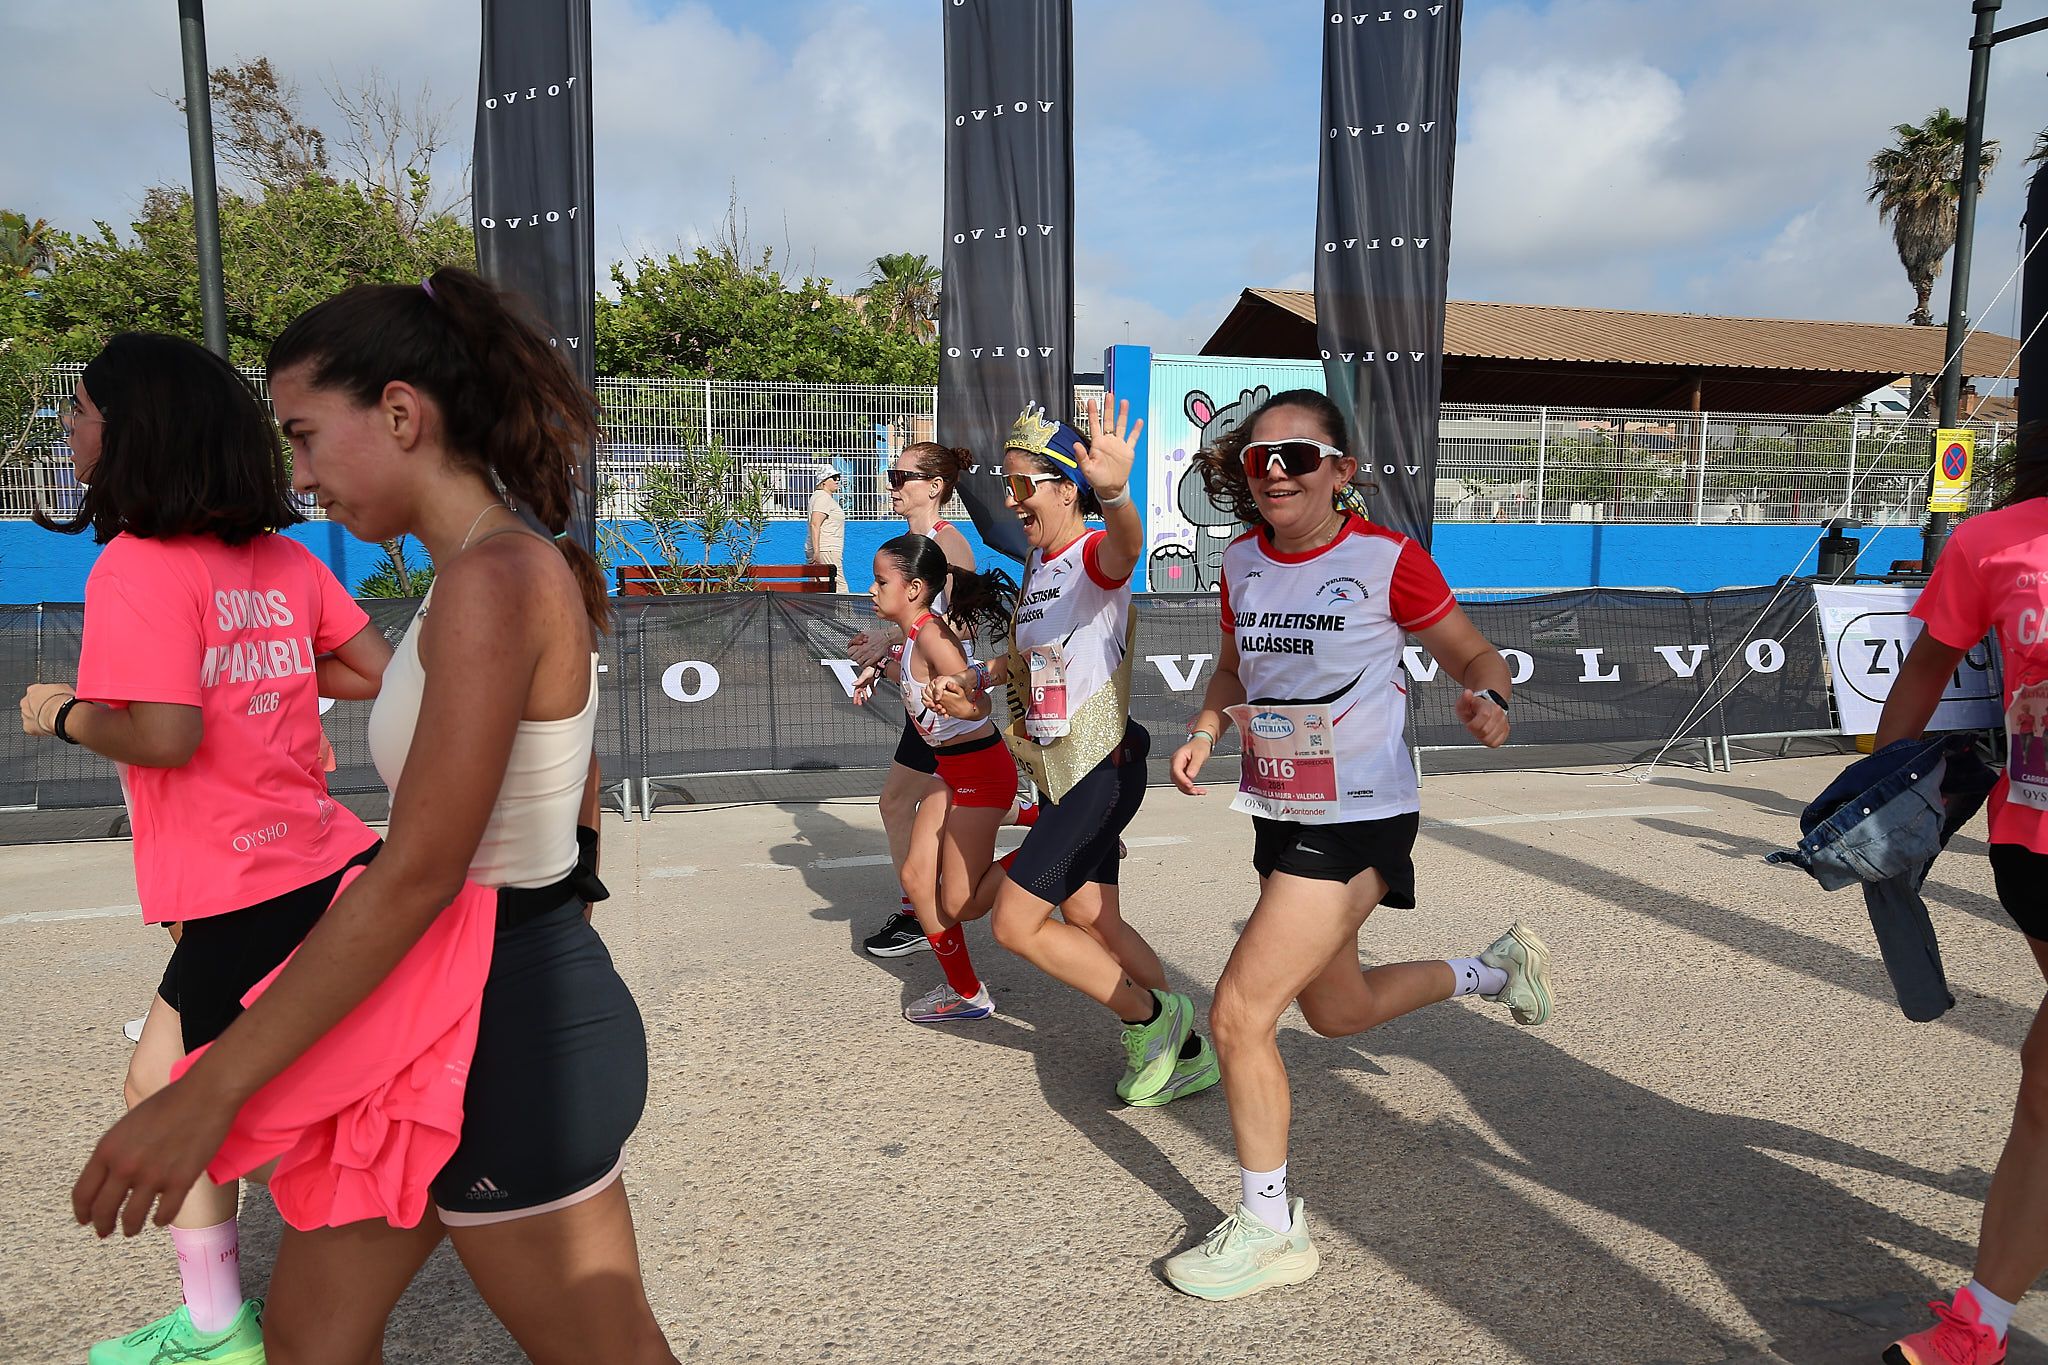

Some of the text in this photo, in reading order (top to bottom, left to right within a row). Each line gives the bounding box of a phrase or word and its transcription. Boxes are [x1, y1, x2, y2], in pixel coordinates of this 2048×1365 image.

[215, 589, 294, 632] SOMOS
[1259, 612, 1346, 632] ATLETISME
[1241, 633, 1314, 656] ALCÀSSER
[200, 635, 317, 689] MPARABL
[247, 691, 280, 717] 2026
[1252, 722, 1292, 734] ASTURIANA
[1257, 758, 1296, 779] 016
[232, 822, 288, 852] OYSHO
